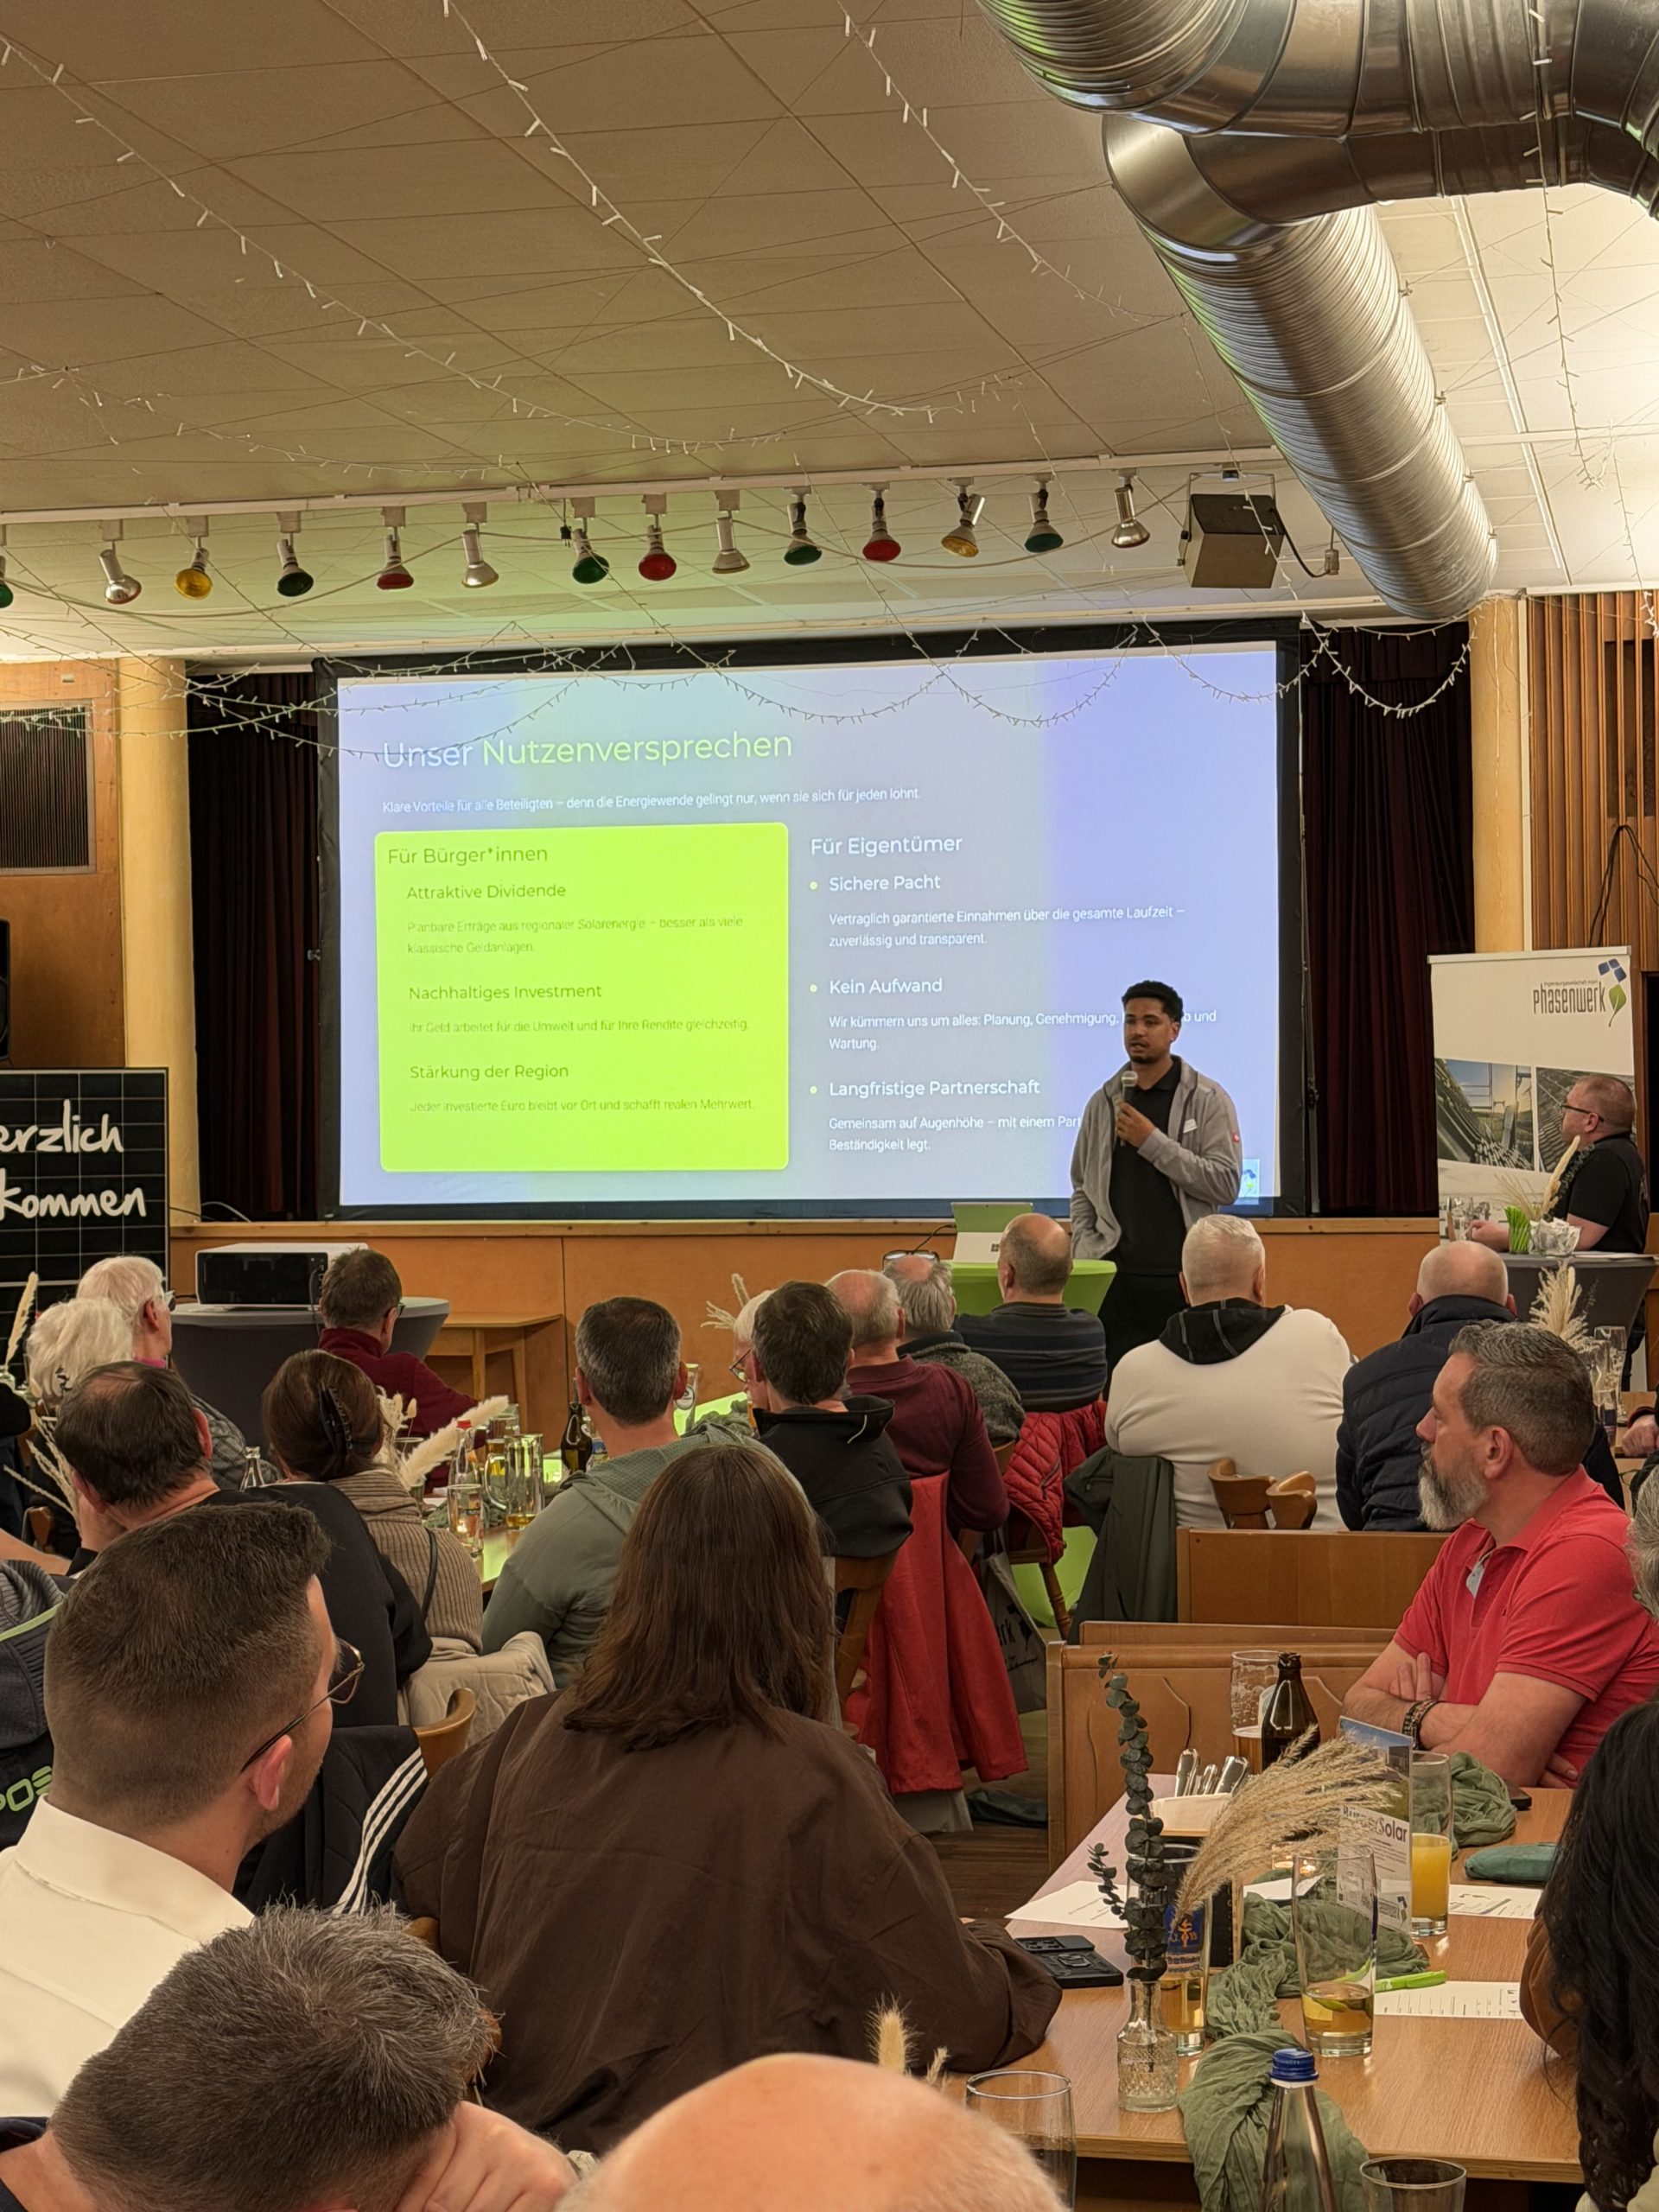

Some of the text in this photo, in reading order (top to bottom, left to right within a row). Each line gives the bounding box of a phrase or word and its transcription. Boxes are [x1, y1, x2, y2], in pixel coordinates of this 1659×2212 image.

[383, 730, 792, 769] Unser Nutzenversprechen
[382, 801, 411, 813] Klare
[412, 800, 454, 812] Vorteile
[457, 799, 473, 812] für
[474, 799, 494, 811] alle
[496, 798, 554, 812] Beteiligten
[566, 797, 594, 809] denn
[596, 795, 614, 809] die
[615, 793, 694, 810] Energiewende
[695, 792, 734, 809] gelingt
[735, 793, 758, 804] nur,
[759, 792, 791, 804] wenn
[792, 790, 810, 803] sie
[811, 789, 836, 802] sich
[837, 789, 855, 802] für
[855, 788, 887, 804] jeden
[889, 787, 921, 800] lohnt.
[811, 836, 963, 857] Für Eigentümer
[388, 848, 418, 865] Für
[406, 883, 567, 900] Attraktive Dividende
[829, 874, 941, 892] Sichere Pacht
[457, 920, 497, 934] Erträge
[499, 922, 519, 931] aus
[521, 919, 575, 933] regionaler
[577, 918, 646, 932] Solarenergie
[658, 918, 696, 929] besser
[698, 917, 715, 928] als
[717, 915, 744, 928] viele
[829, 912, 890, 928] Vertraglich
[892, 912, 955, 927] garantierte
[957, 909, 1021, 923] Einnahmen
[1023, 908, 1051, 921] über
[1052, 908, 1071, 921] die
[1072, 907, 1124, 923] gesamte
[1126, 905, 1173, 919] Laufzeit
[407, 943, 464, 955] klassische
[829, 932, 988, 949] zuverlässig und transparent.
[409, 985, 602, 1002] Nachhaltiges Investment
[830, 977, 943, 995] Kein Aufwand
[425, 1021, 451, 1033] Geld
[453, 1021, 493, 1033] arbeitet
[496, 1020, 512, 1033] für
[513, 1021, 531, 1033] die
[532, 1020, 575, 1033] Umwelt
[576, 1020, 598, 1032] und
[600, 1020, 615, 1032] für
[618, 1020, 639, 1031] Ihre
[641, 1019, 683, 1031] Rendite
[829, 1015, 849, 1028] Wir
[850, 1016, 905, 1028] kümmern
[906, 1017, 928, 1027] uns
[931, 1015, 950, 1027] um
[951, 1014, 981, 1027] alles:
[983, 1014, 1033, 1027] Planung,
[1035, 1012, 1118, 1027] Genehmigung,
[1193, 1008, 1217, 1023] und
[829, 1038, 880, 1052] Wartung.
[410, 1064, 569, 1082] Stärkung der Region
[830, 1078, 1040, 1100] Langfristige Partnerschaft
[410, 1098, 754, 1112] Jeder investierte Euro bleibt vor Ort und schafft realen Mehrwert.
[829, 1117, 897, 1130] Gemeinsam
[899, 1116, 918, 1129] auf
[919, 1116, 984, 1131] Augenhöhe
[997, 1116, 1017, 1129] mit
[1019, 1116, 1055, 1128] einem
[829, 1137, 931, 1154] Beständigkeit legt.
